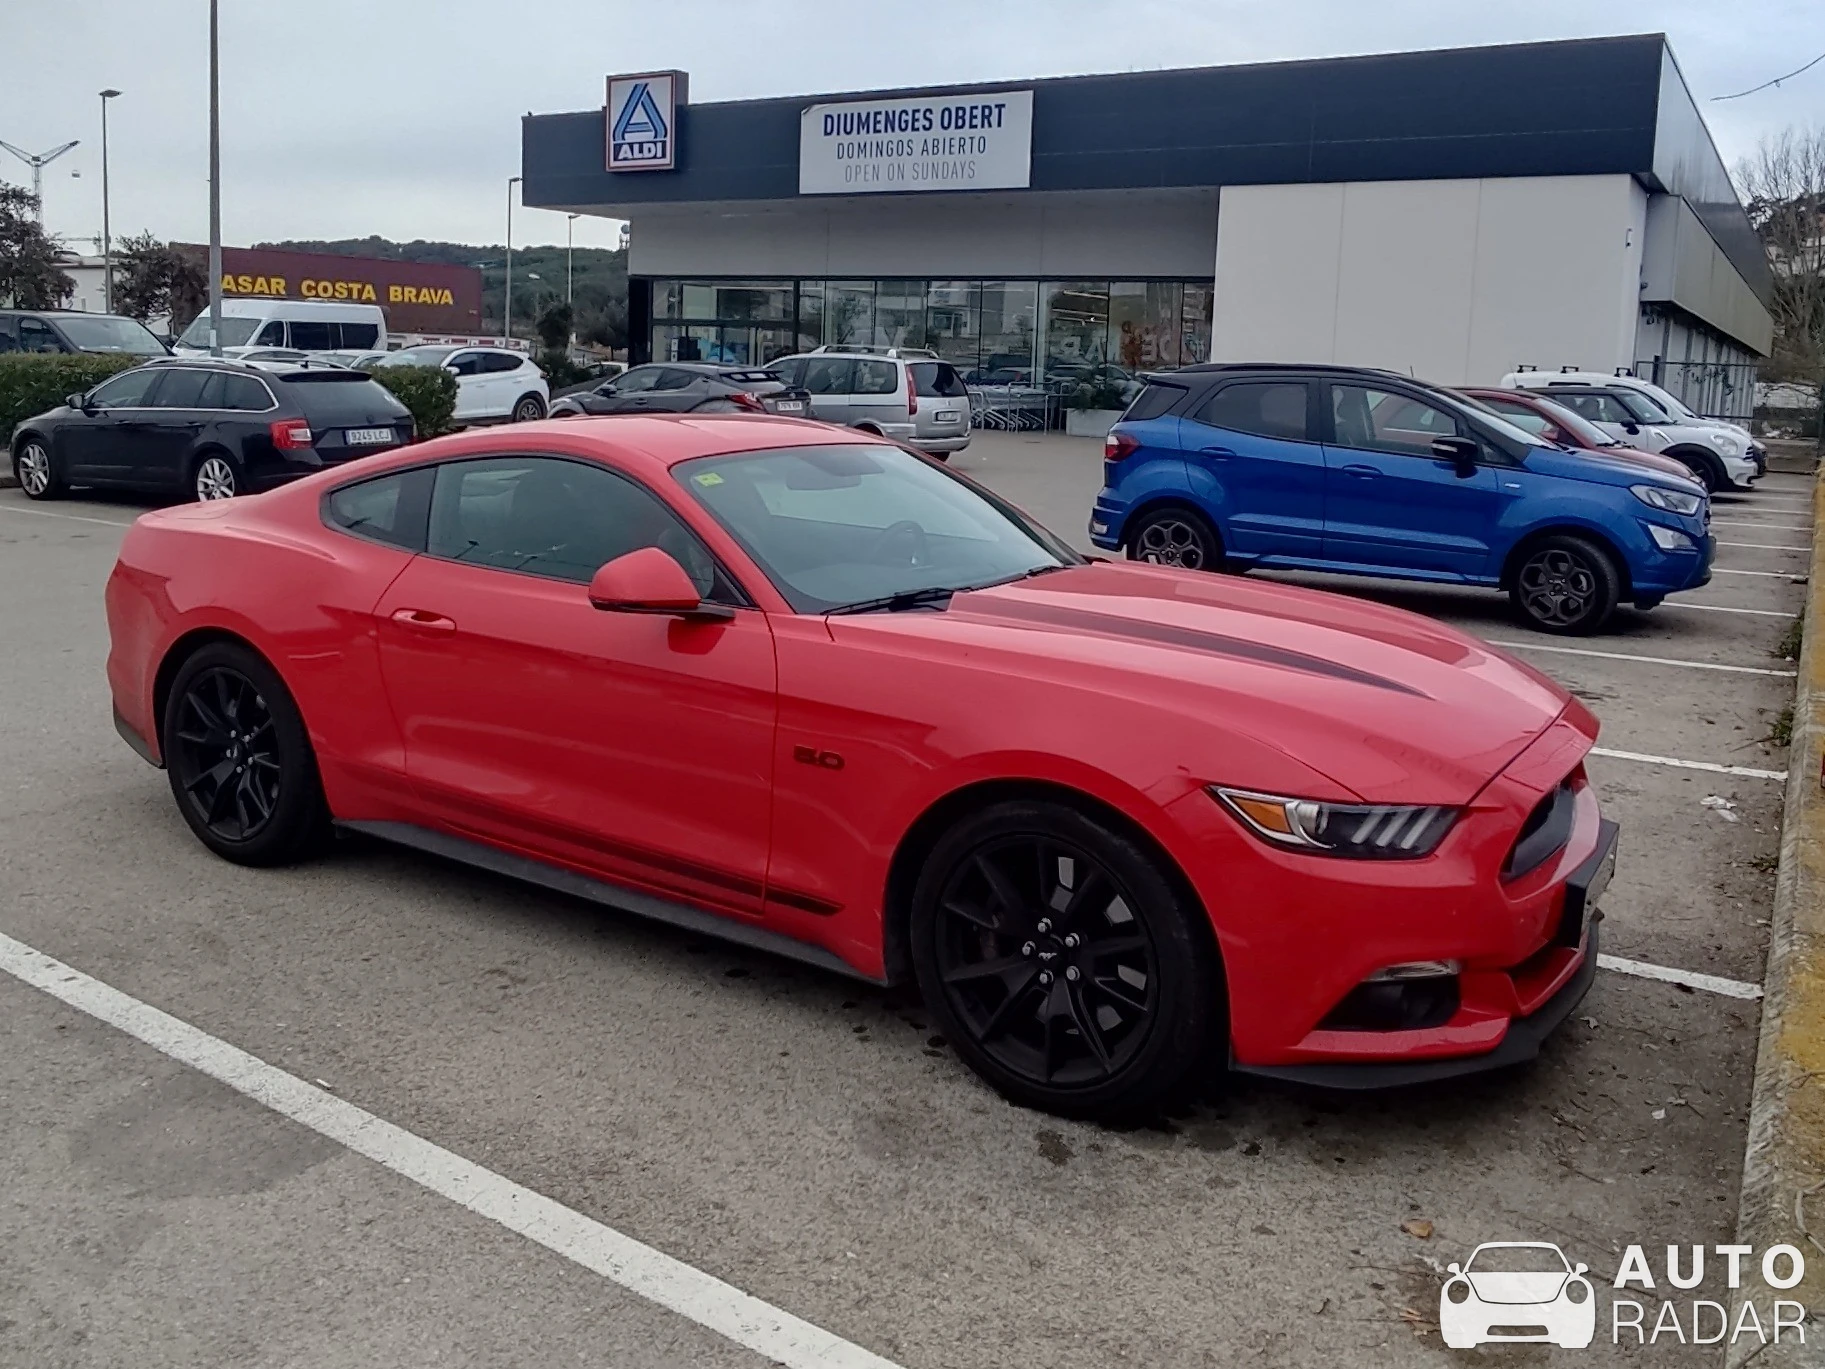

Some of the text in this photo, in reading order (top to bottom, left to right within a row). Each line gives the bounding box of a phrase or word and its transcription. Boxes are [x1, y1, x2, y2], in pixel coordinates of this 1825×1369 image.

[823, 103, 1006, 136] DIUMENGES OBERT
[618, 142, 663, 160] ALDI
[837, 136, 986, 160] DOMINGOS ABIERTO
[845, 160, 976, 183] OPEN ON SUNDAYS
[221, 275, 454, 305] ASAR COSTA BRAVA
